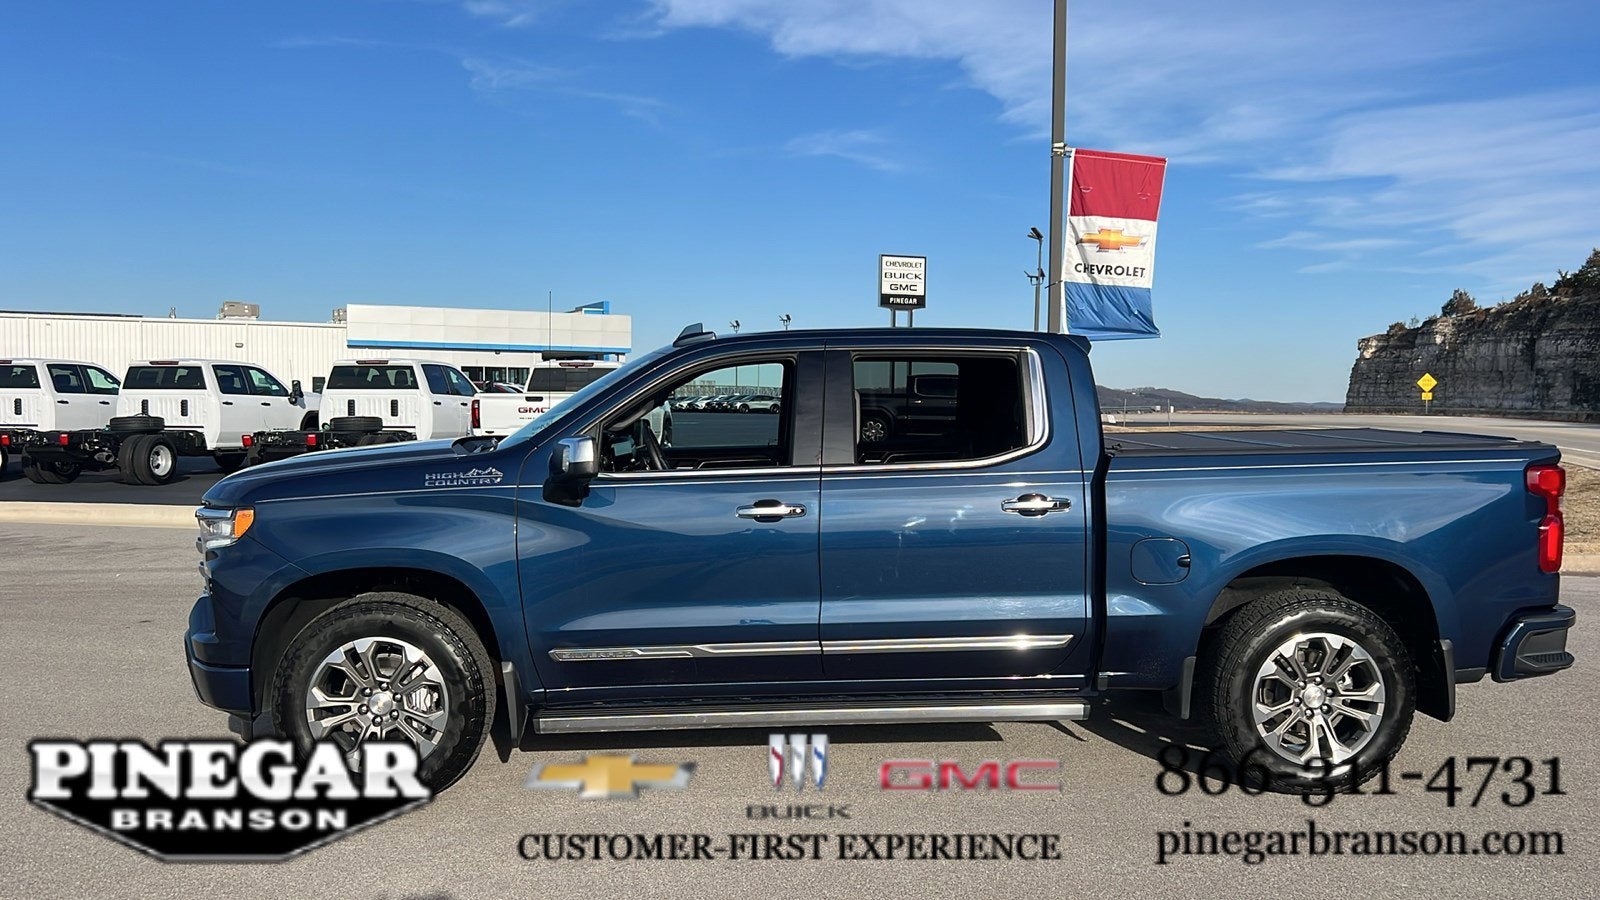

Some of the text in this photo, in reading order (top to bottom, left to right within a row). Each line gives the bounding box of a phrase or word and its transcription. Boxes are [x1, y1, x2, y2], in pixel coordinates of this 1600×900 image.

[885, 260, 922, 268] CHEVROLET
[1074, 262, 1146, 278] CHEVROLET
[884, 272, 923, 280] BUICK
[889, 283, 918, 292] GMC
[425, 472, 464, 480] HIGH
[425, 478, 503, 487] COUNTRY
